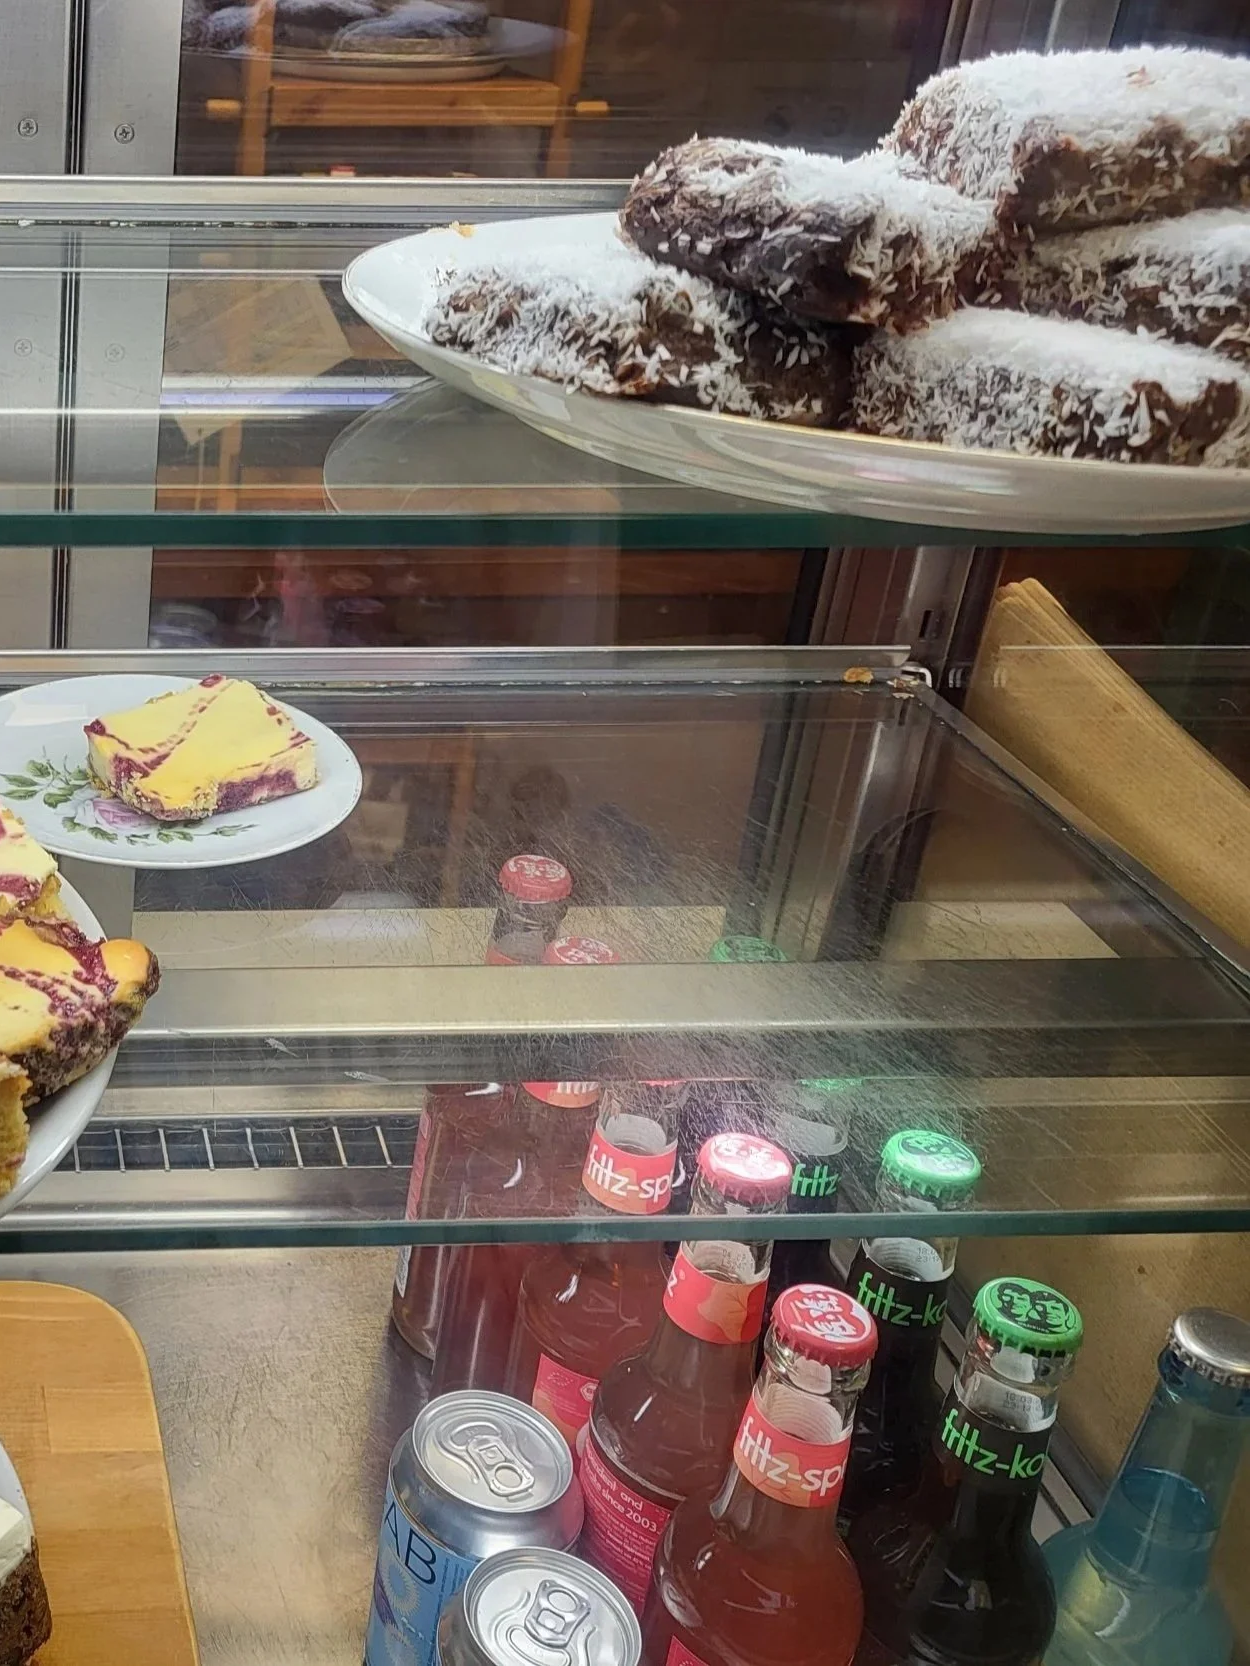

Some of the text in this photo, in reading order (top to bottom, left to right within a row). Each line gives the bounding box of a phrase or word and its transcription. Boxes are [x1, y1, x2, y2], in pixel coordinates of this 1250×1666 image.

[941, 1408, 1045, 1479] fritz-ko
[602, 1488, 625, 1513] since
[620, 1491, 643, 1511] and
